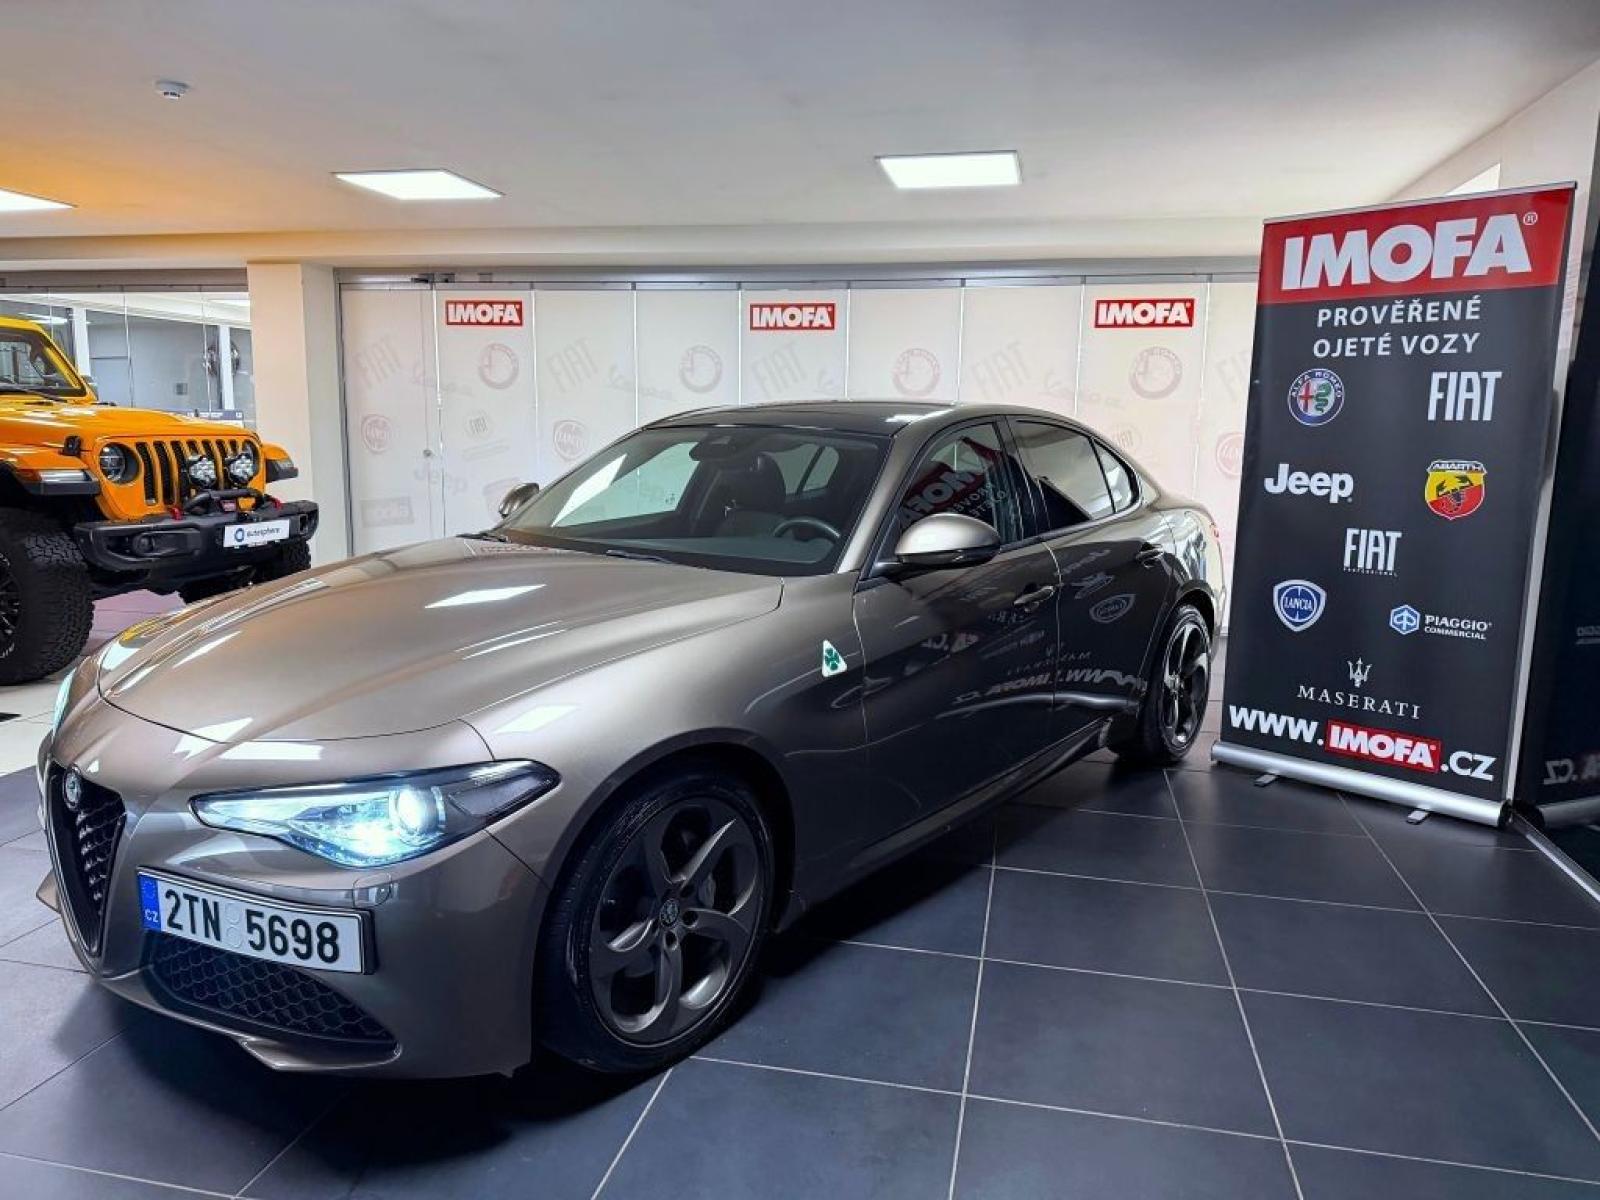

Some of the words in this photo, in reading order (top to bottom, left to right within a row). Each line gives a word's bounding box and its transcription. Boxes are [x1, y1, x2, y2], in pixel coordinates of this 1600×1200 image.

[1316, 295, 1481, 328] PROVĚŘENÉ
[1313, 333, 1391, 359] OJETÉ
[1401, 332, 1480, 355] VOZY
[1427, 371, 1503, 421] FIAT
[1264, 463, 1353, 503] Jeep
[1343, 527, 1403, 571] FIAT
[1297, 685, 1421, 720] MASERATI
[144, 909, 159, 923] CZ
[164, 889, 222, 942] 2TN
[246, 909, 340, 964] 5698
